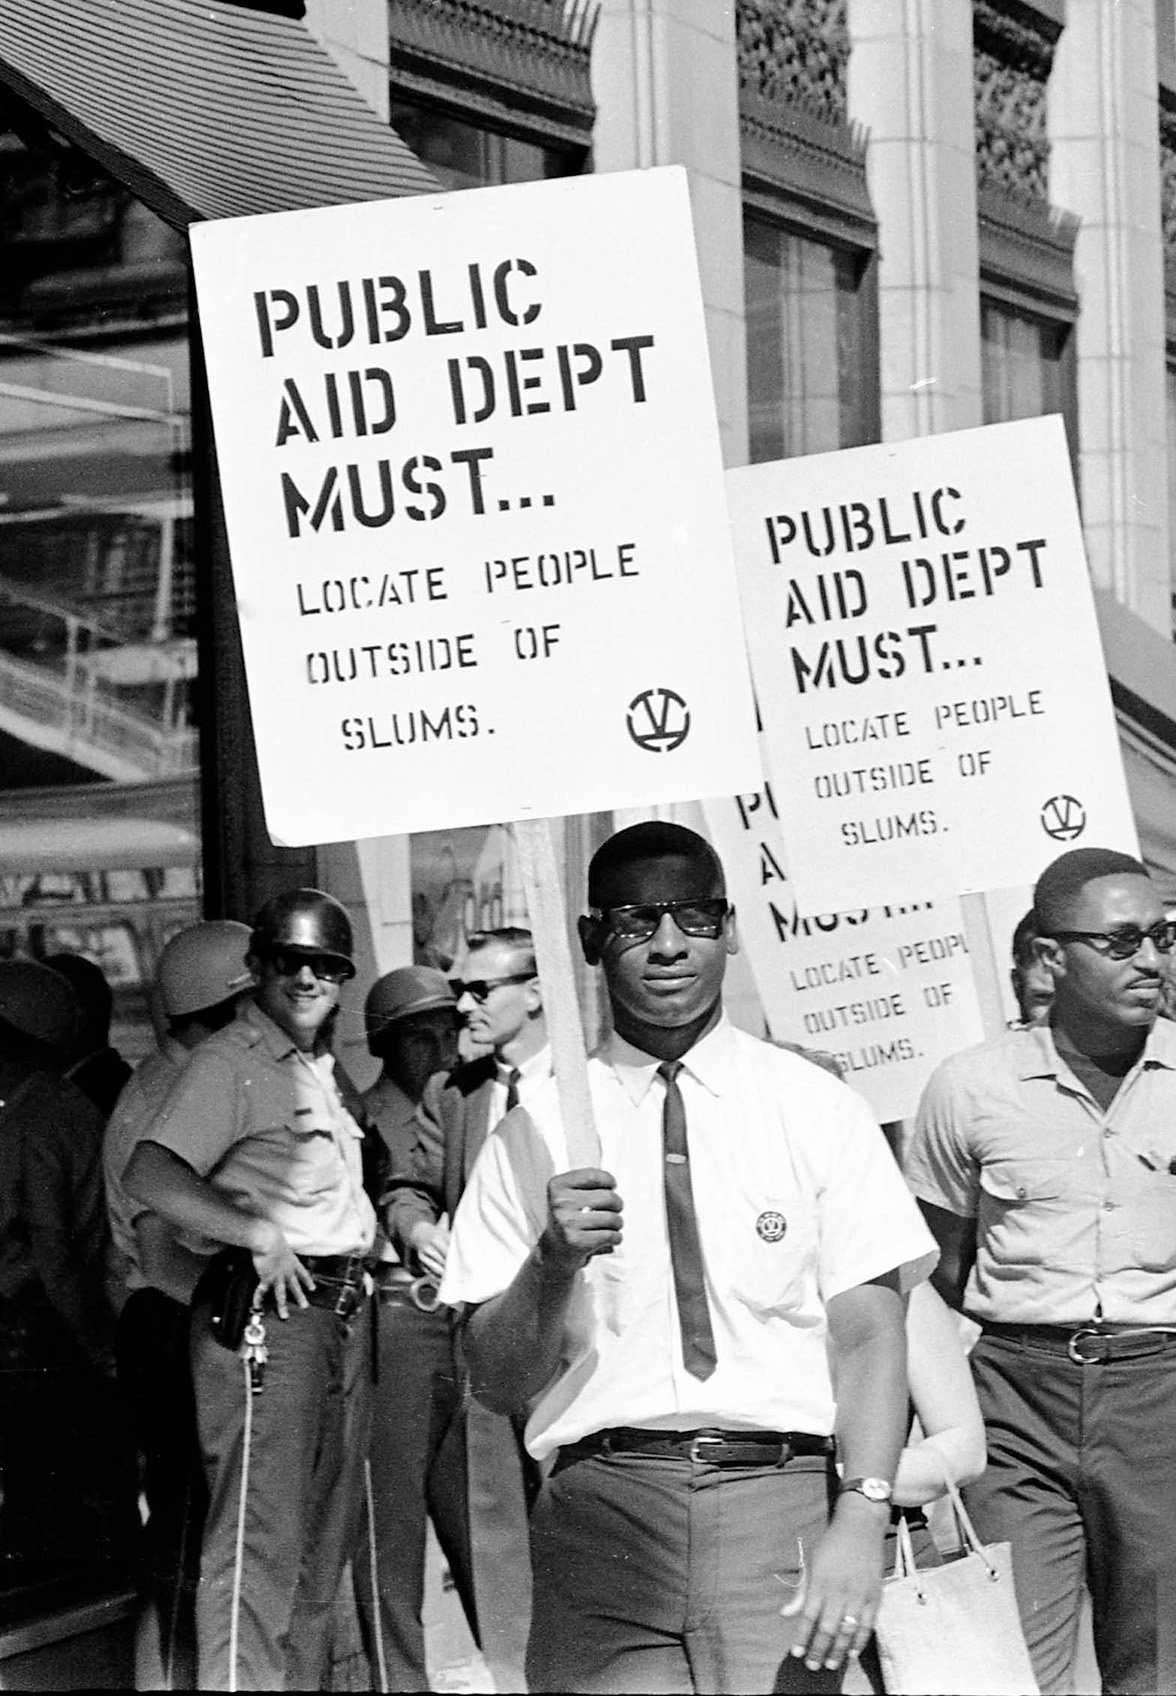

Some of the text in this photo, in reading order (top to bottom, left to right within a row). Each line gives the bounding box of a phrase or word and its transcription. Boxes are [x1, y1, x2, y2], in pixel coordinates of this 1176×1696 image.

[254, 259, 541, 357] PUBLIC
[276, 335, 654, 447] AID DEPT
[281, 447, 555, 538] MUST...
[765, 487, 965, 565] PUBLIC
[297, 543, 639, 616] LOCATE PEOPLE
[786, 539, 1046, 628] AID DEPT
[307, 624, 560, 684] OUTSIDE OF
[791, 624, 982, 693] MUST...
[342, 705, 494, 750] SLUMS.
[806, 690, 1044, 749] LOCATE PEOPLE
[815, 751, 990, 798] OUTSIDE OF
[842, 811, 949, 845] SLUMS.
[791, 935, 969, 991] LOCATE PEOPL
[804, 983, 951, 1033] OUTSIDE OF
